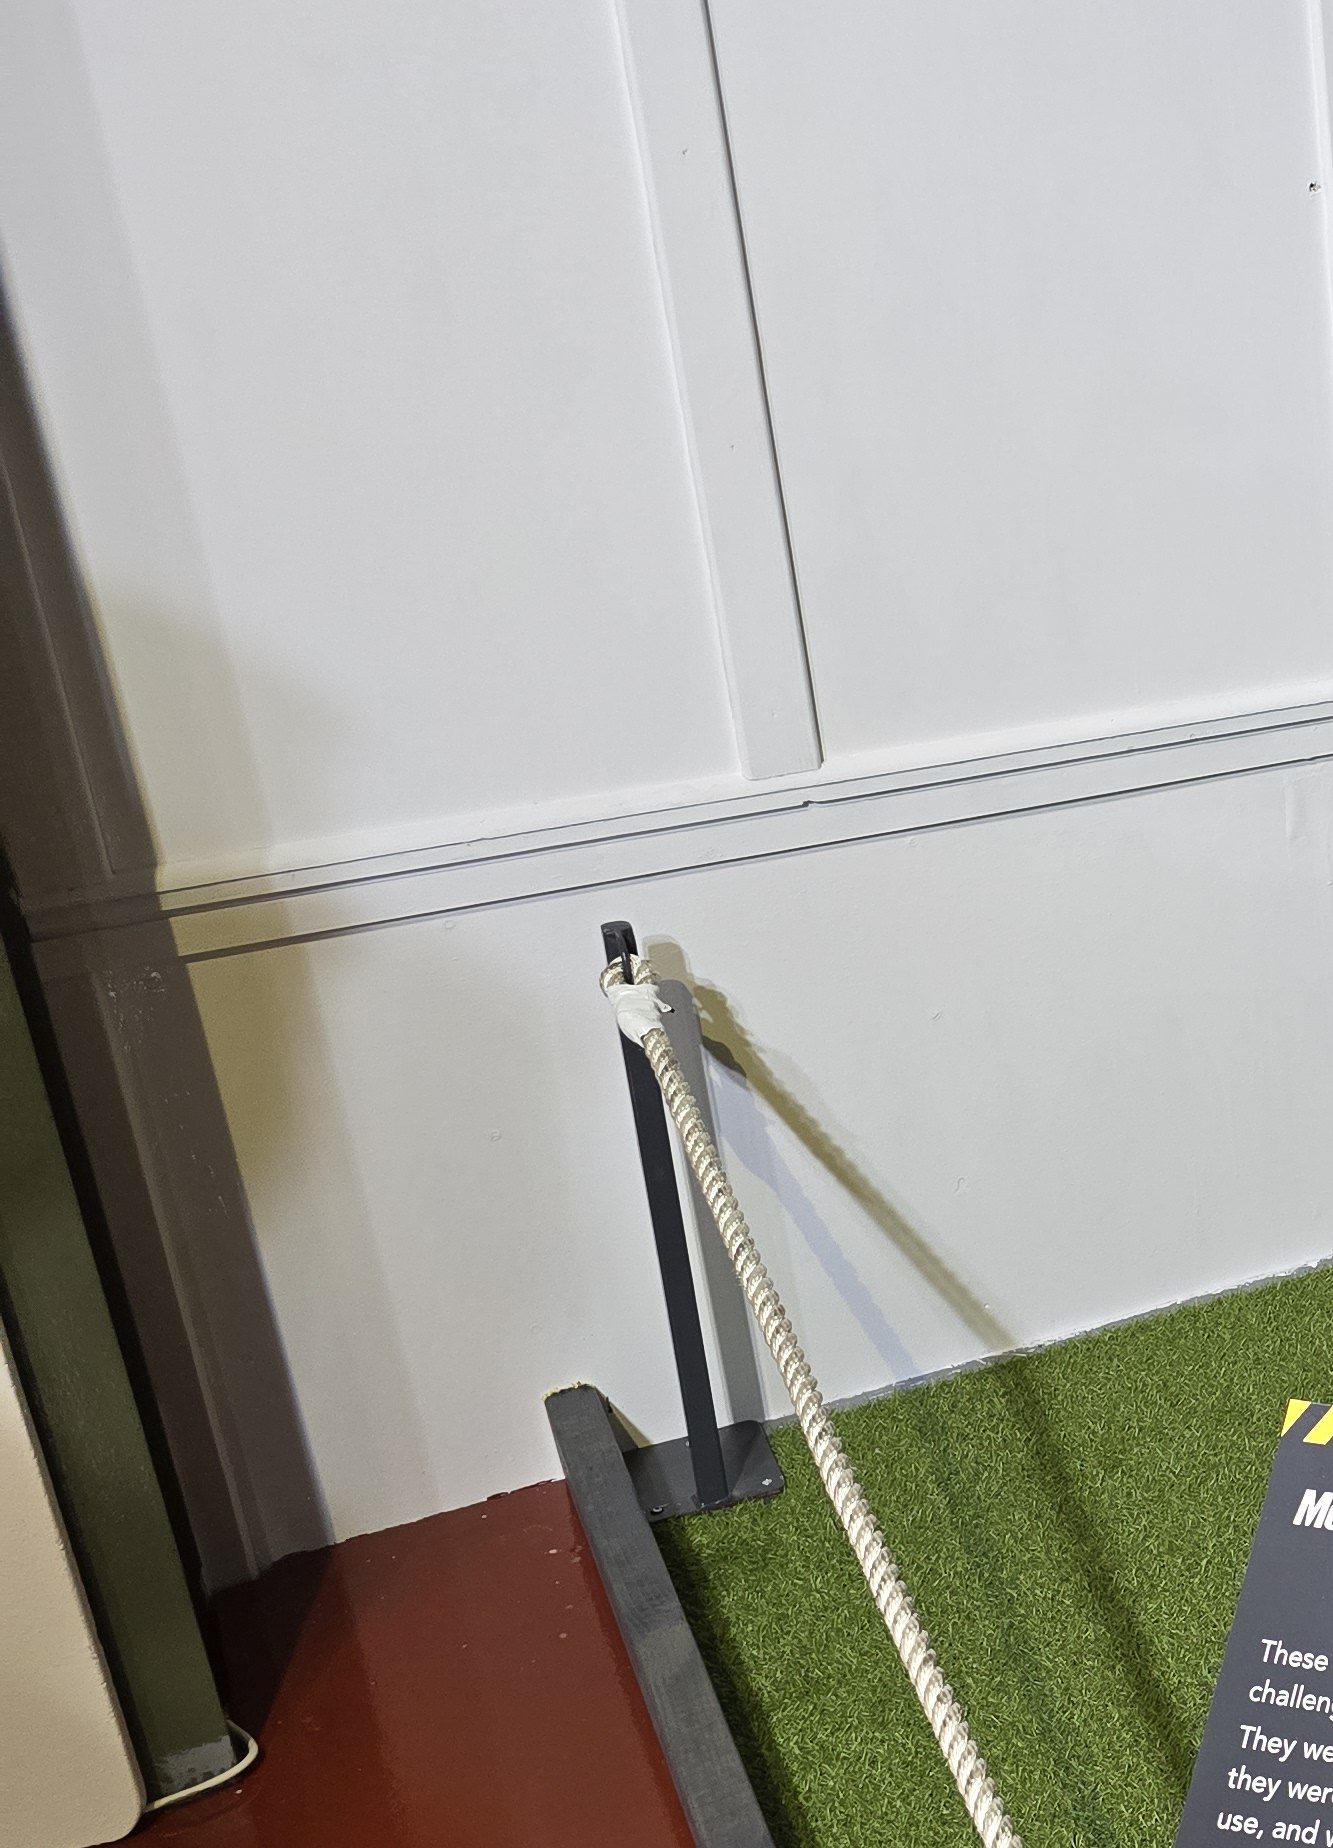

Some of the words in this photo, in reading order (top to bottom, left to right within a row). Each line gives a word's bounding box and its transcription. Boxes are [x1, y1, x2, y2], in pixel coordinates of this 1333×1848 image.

[1261, 1638, 1329, 1672] These
[1239, 1724, 1298, 1763] They
[1227, 1764, 1282, 1802] they
[1216, 1811, 1264, 1840] use,
[1271, 1818, 1321, 1845] and
